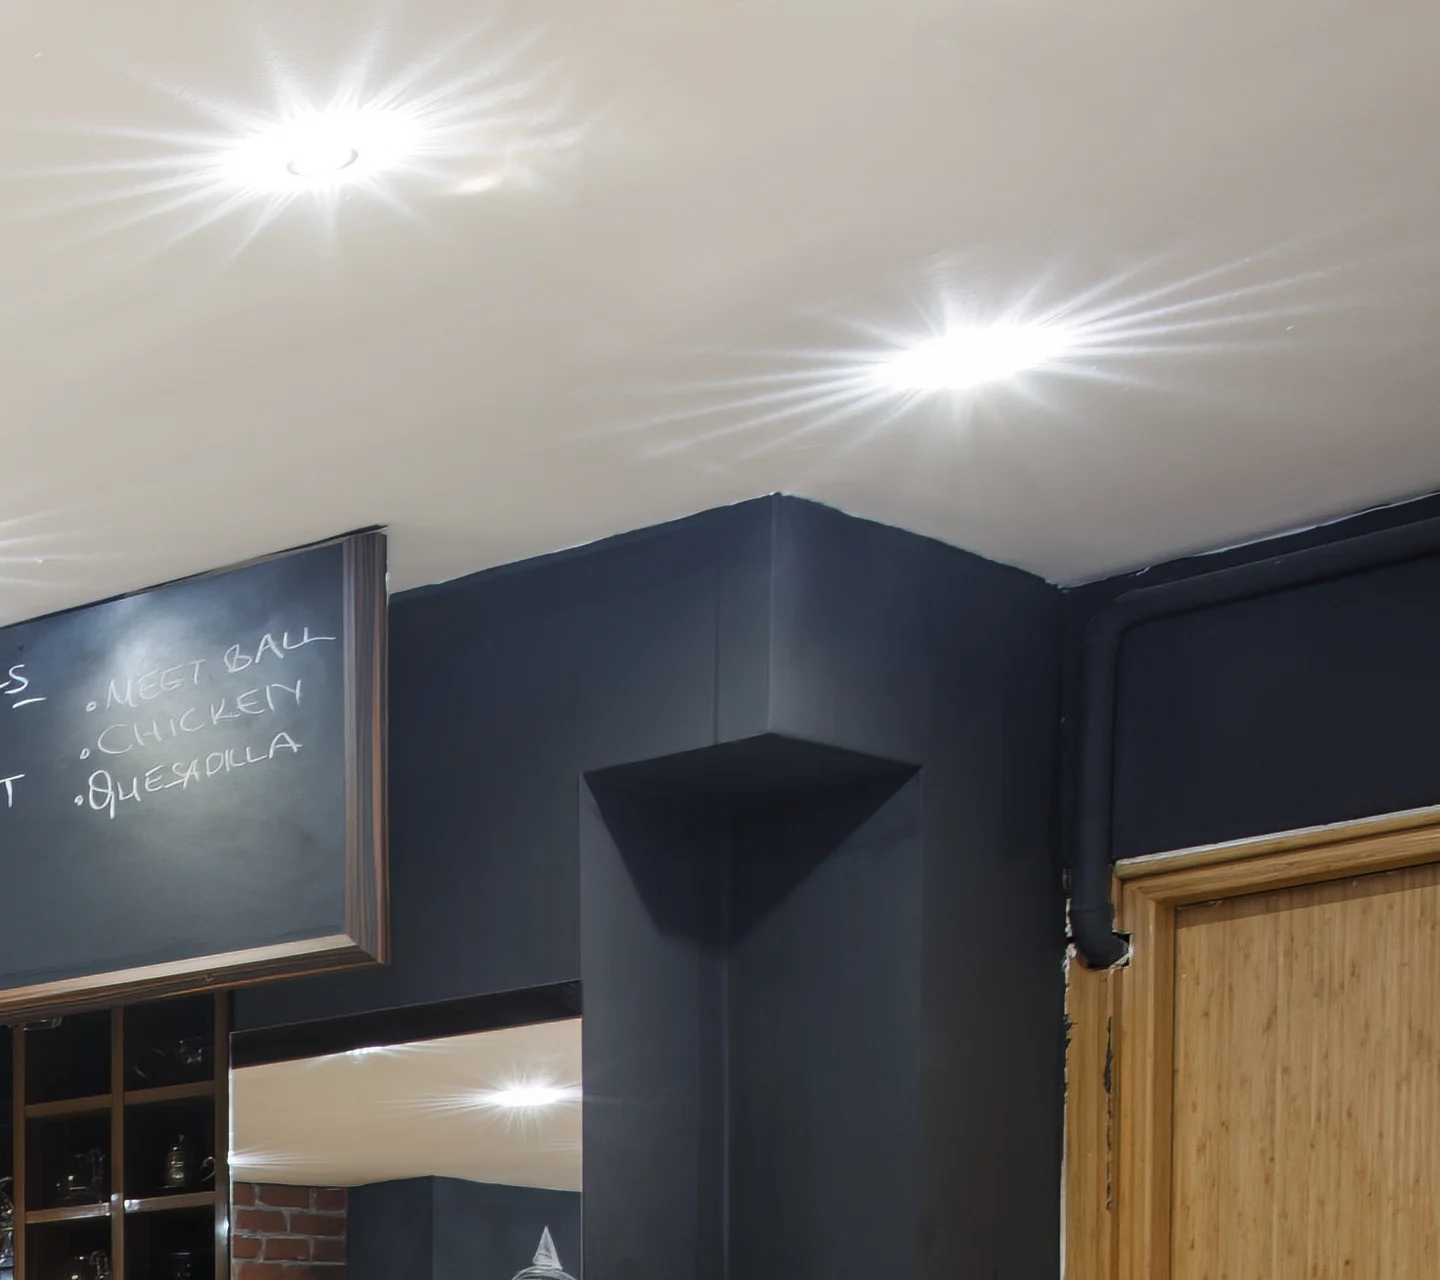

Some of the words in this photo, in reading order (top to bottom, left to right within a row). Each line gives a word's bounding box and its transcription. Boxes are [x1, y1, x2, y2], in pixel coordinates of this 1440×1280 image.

[106, 659, 206, 710] MEET
[223, 626, 337, 673] BALL
[96, 678, 304, 756] CHICKEN
[87, 730, 304, 821] QUESADILLA
